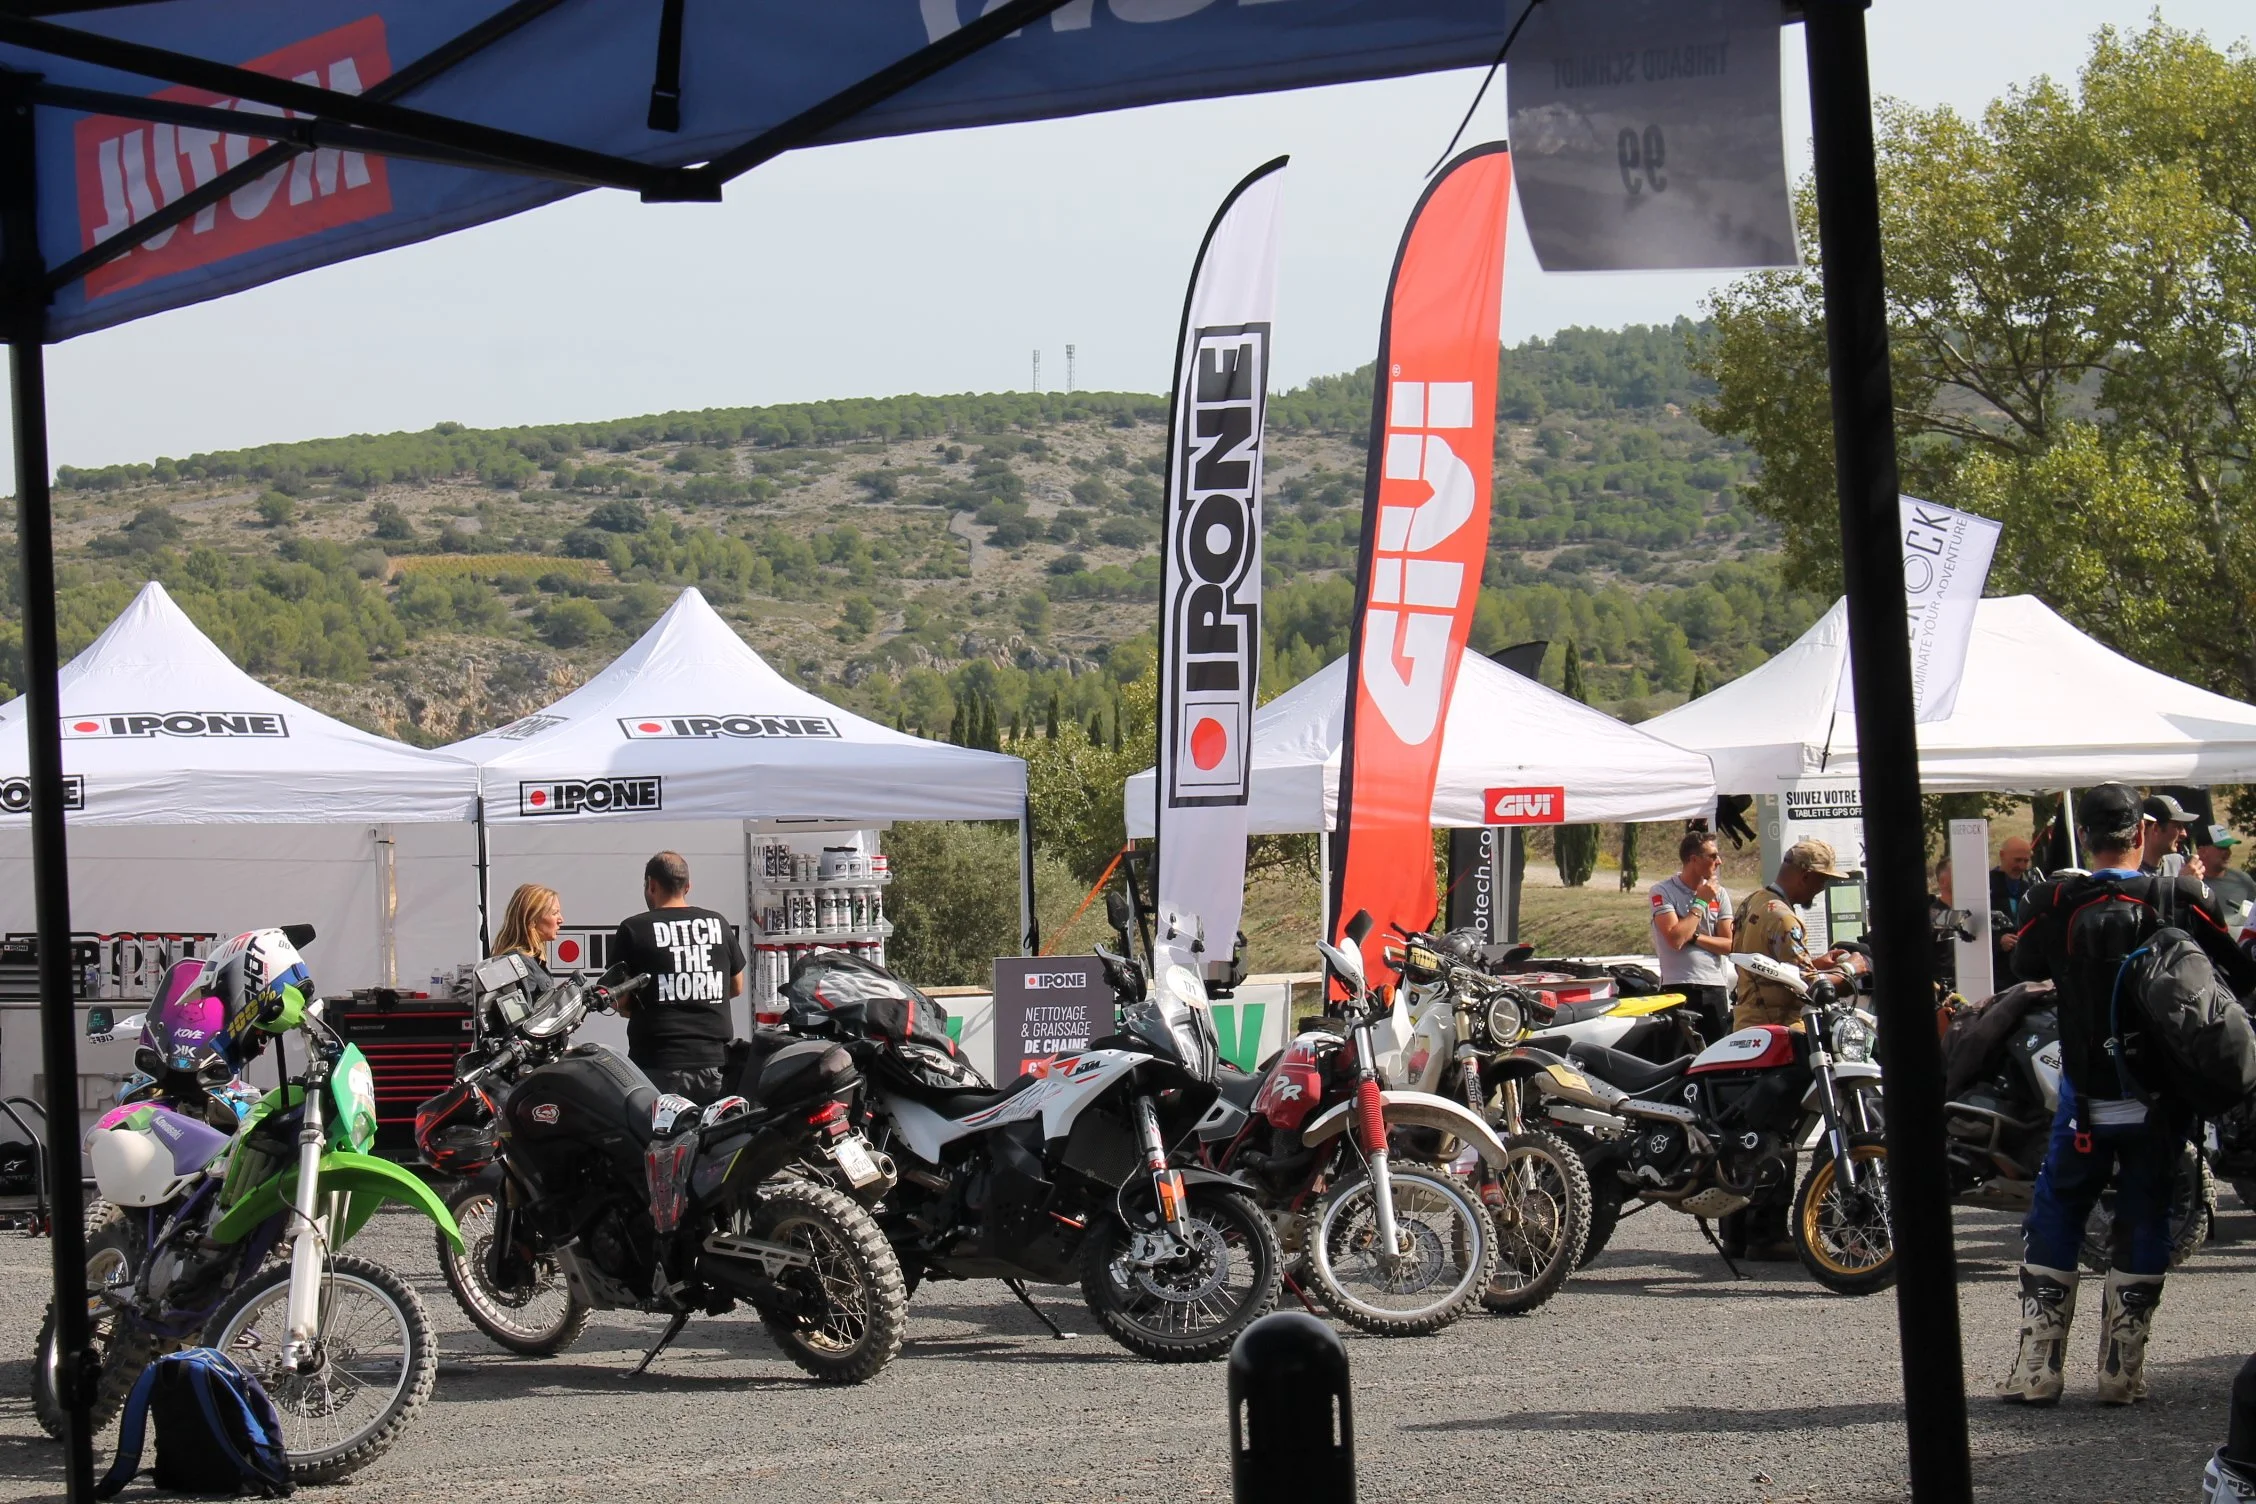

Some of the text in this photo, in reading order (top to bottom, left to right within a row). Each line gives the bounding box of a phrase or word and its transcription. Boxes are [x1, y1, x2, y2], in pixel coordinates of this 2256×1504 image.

[1187, 343, 1252, 692] IPONE
[1363, 381, 1476, 746] GIVI
[1922, 601, 1941, 640] YOUR
[1938, 518, 1968, 599] ADVENTURE
[110, 715, 279, 735] IPONE
[672, 717, 831, 736] IPONE
[554, 781, 656, 810] IPONE
[1495, 794, 1551, 817] GIVI
[1786, 789, 1857, 806] SUIVEZ VOTRE
[1794, 808, 1831, 818] TABLETTE
[1832, 807, 1848, 817] GPS
[653, 917, 723, 948] DITCH
[669, 944, 714, 974] THE
[657, 971, 723, 1001] NORM
[1038, 974, 1085, 987] IPONE
[1025, 1005, 1087, 1022] NETTOYAGE
[173, 1028, 206, 1040] KOVE
[1021, 1021, 1092, 1038] & GRAISSAGE
[1024, 1039, 1041, 1054] DE
[1464, 1064, 1479, 1103] Racing
[153, 1114, 185, 1141] Kawasaki
